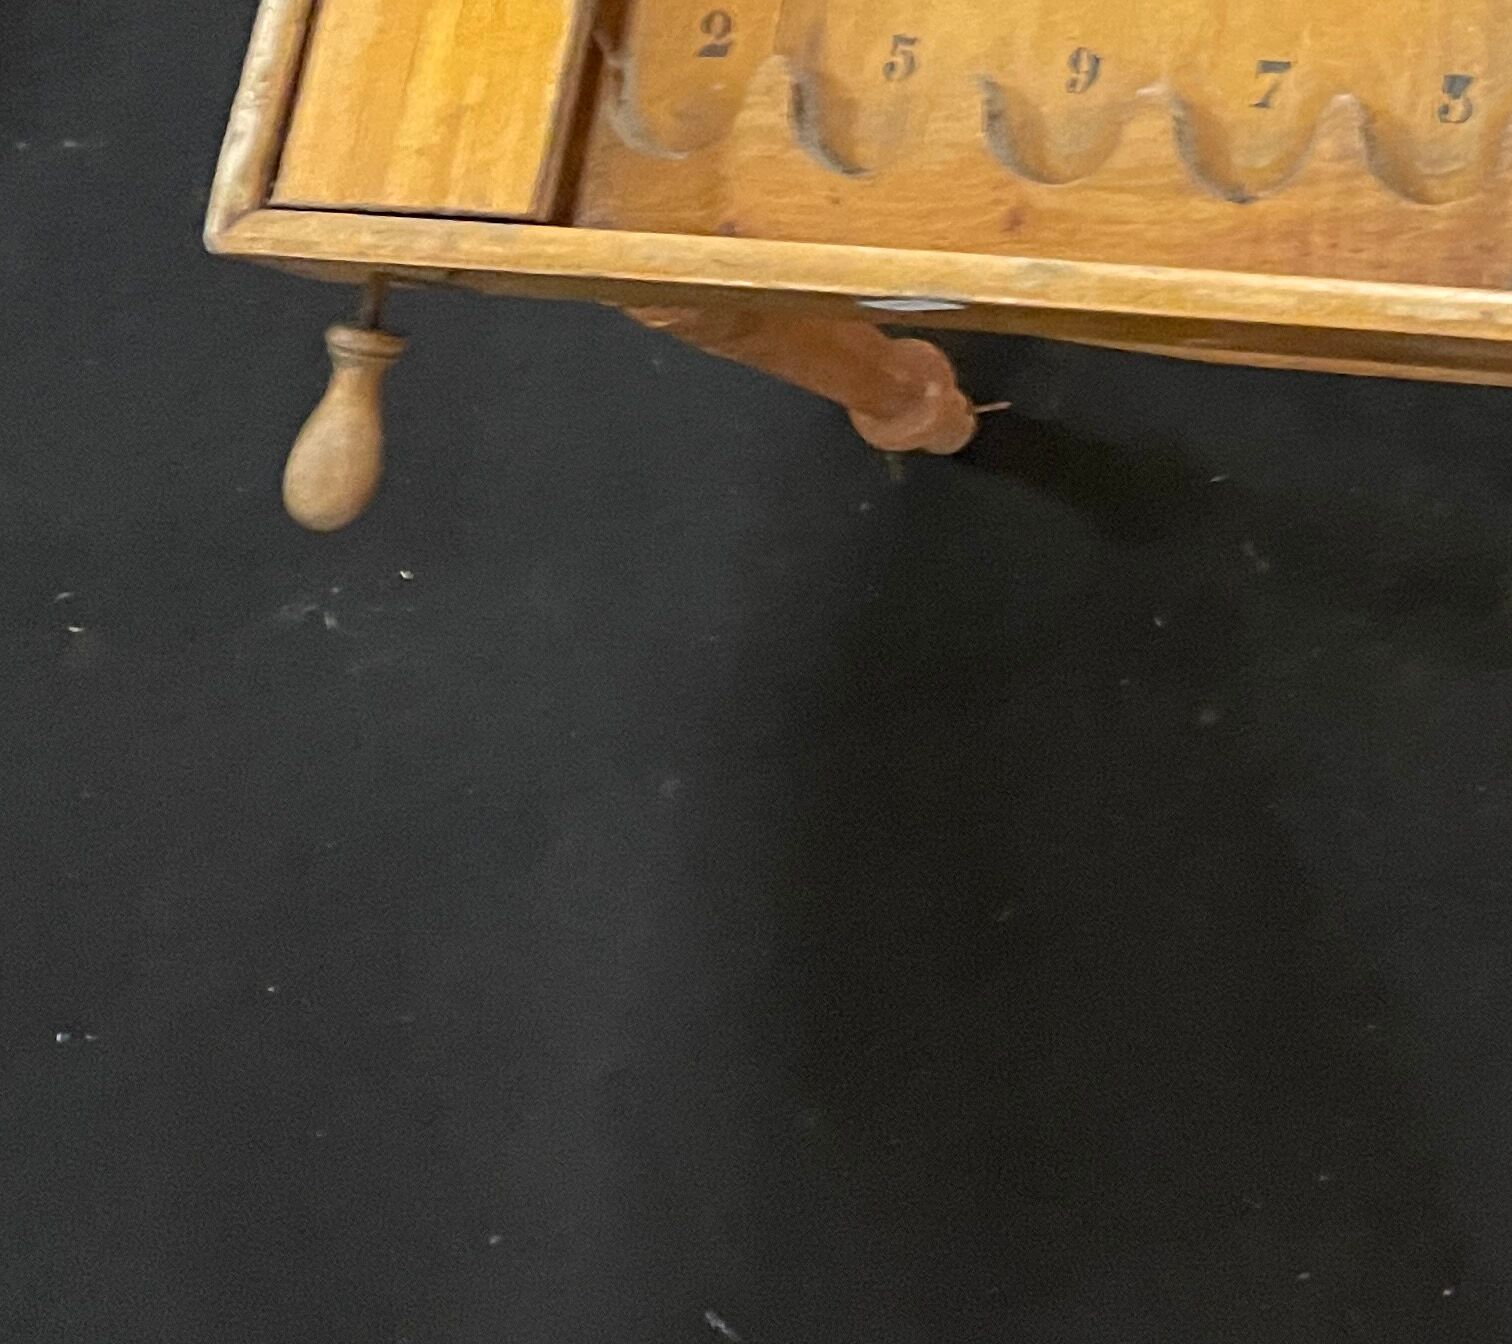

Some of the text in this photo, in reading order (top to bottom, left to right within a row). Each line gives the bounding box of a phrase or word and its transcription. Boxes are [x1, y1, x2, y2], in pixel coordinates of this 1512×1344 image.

[698, 9, 1475, 124] 2 5 9 7 3
